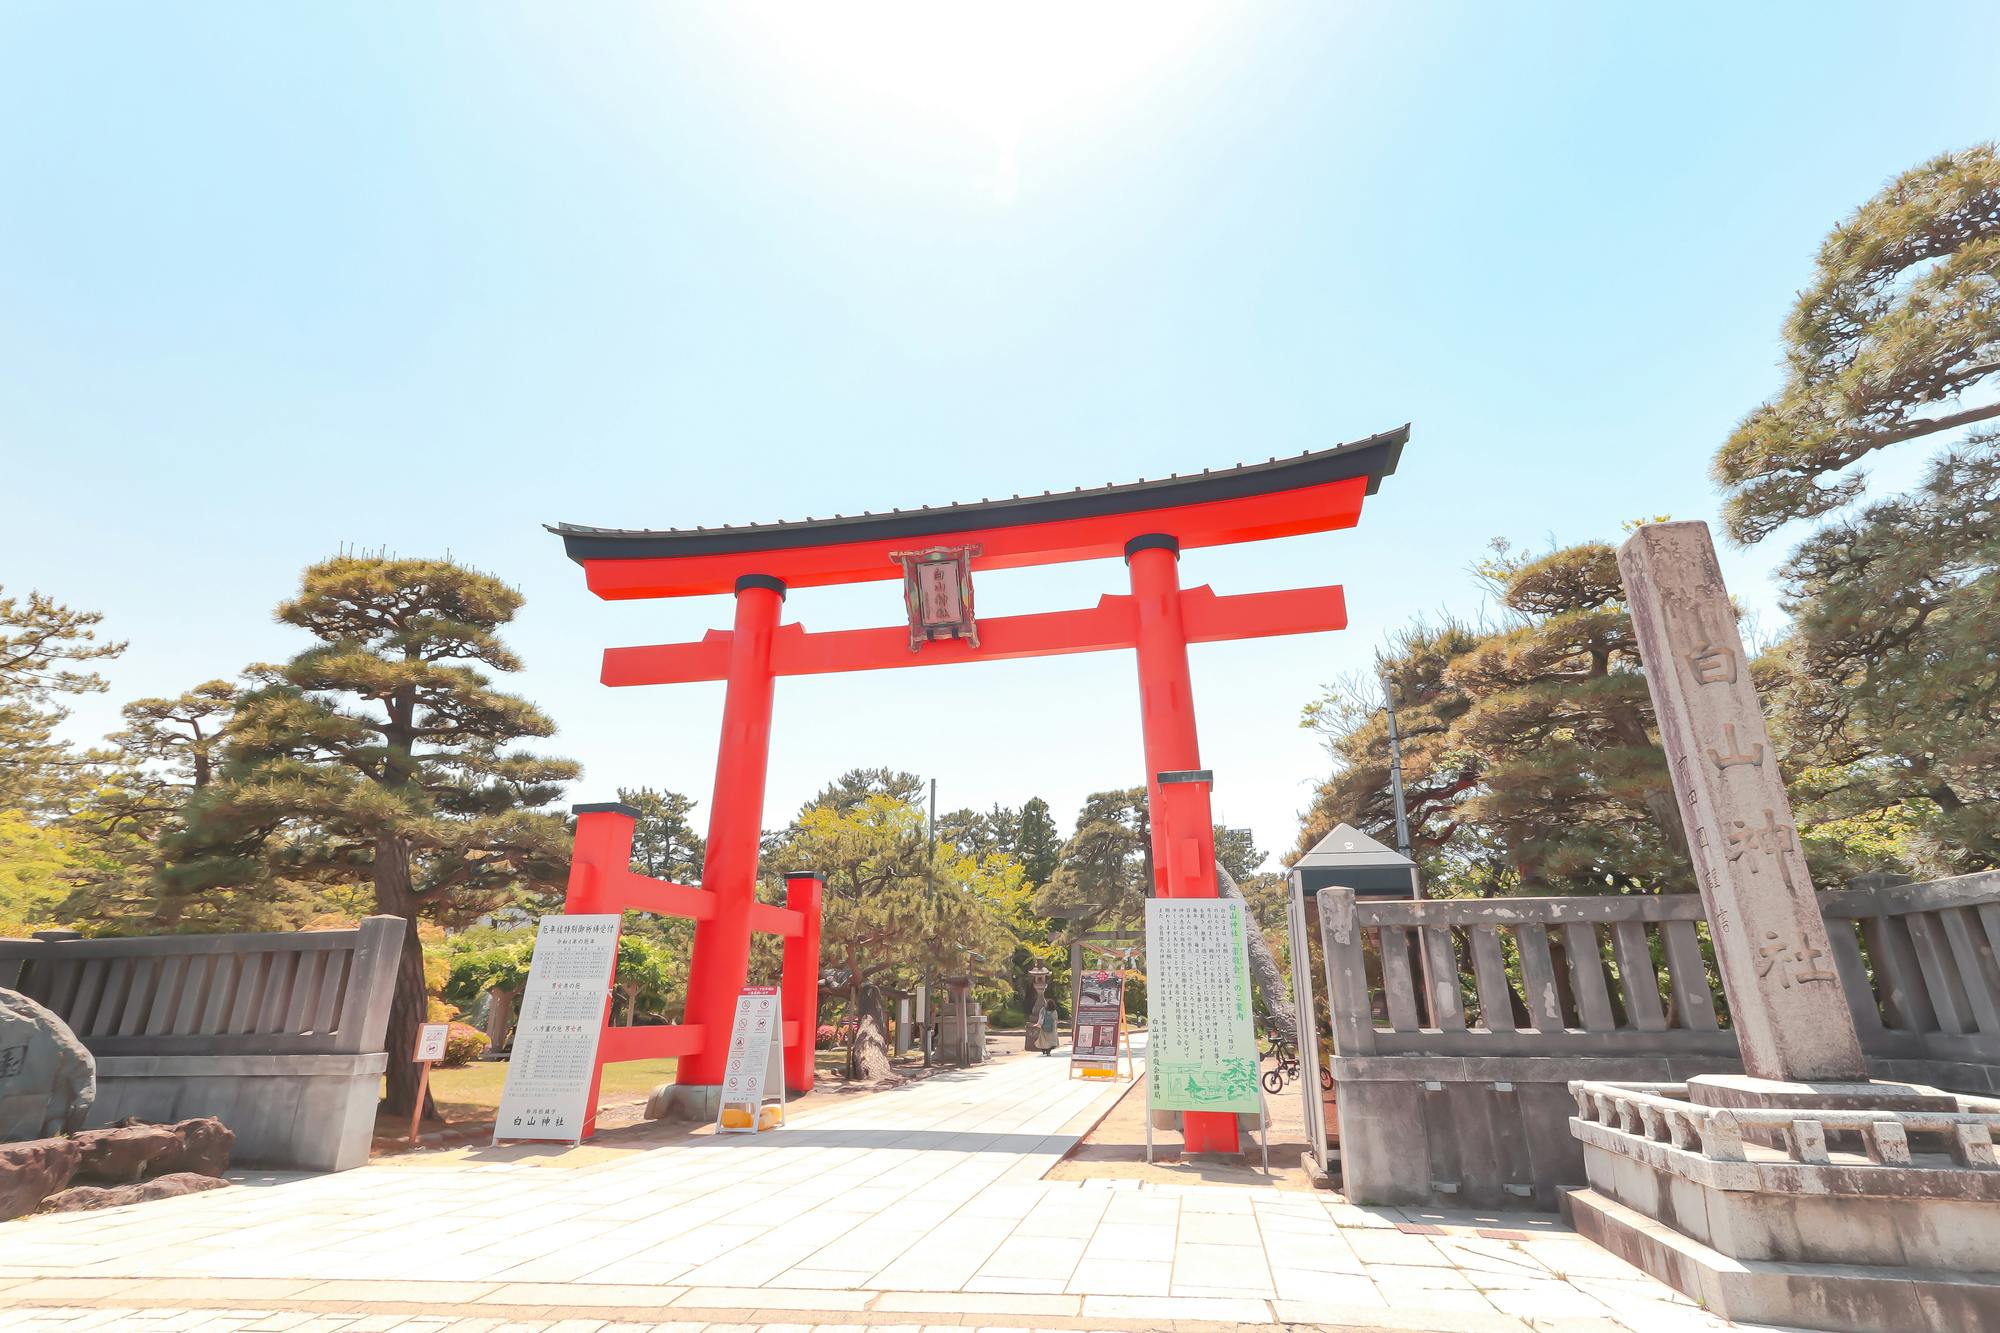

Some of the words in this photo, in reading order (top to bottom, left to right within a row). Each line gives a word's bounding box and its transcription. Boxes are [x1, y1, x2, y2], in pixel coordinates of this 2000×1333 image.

[1684, 645, 1836, 988] 白山神社
[512, 1115, 565, 1126] 白山神社
